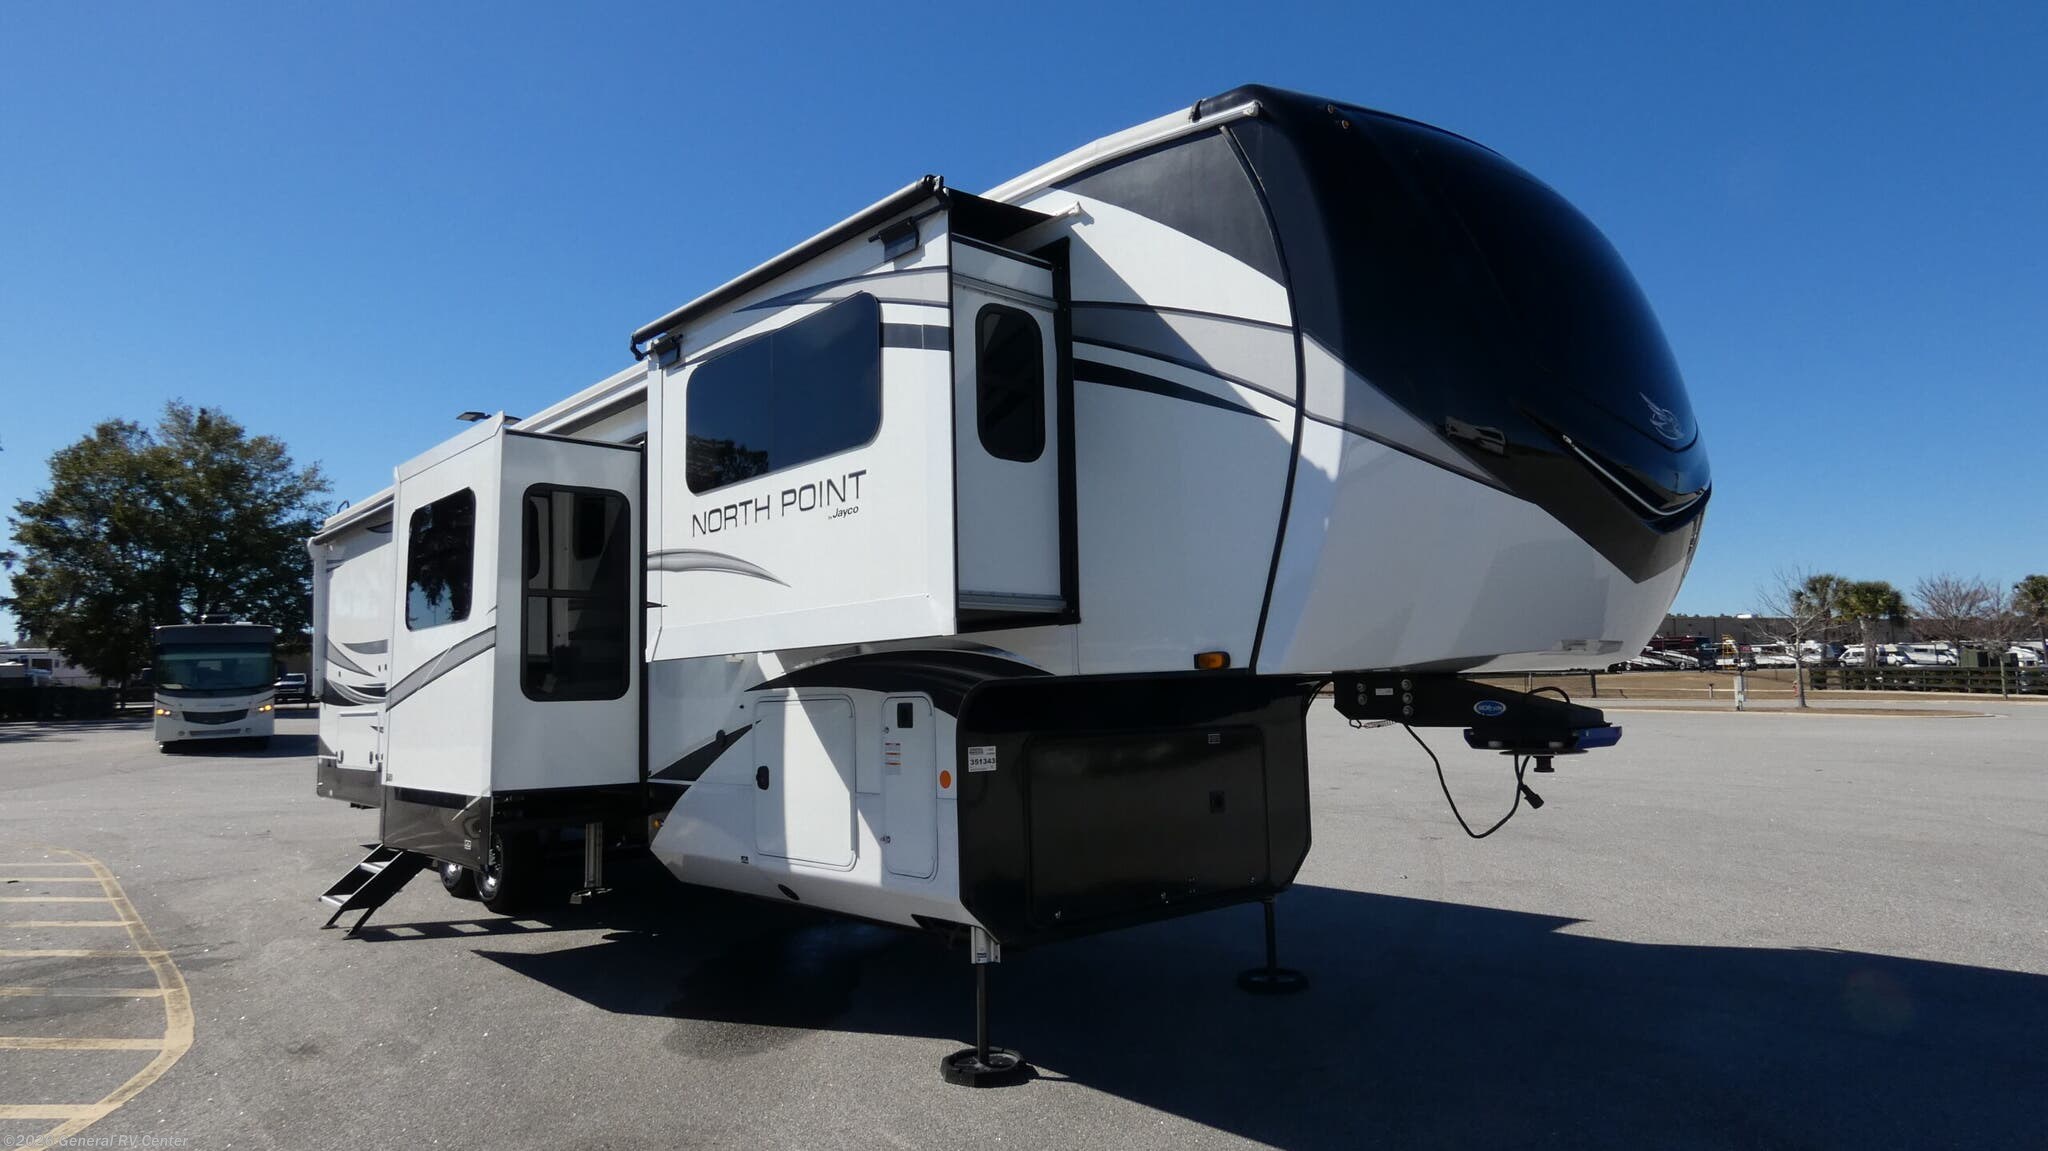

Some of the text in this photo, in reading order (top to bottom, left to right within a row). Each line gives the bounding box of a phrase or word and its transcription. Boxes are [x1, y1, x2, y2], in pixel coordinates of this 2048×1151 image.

[692, 469, 867, 538] NORTH POINT
[832, 506, 859, 518] Jayco
[969, 758, 996, 766] 351343
